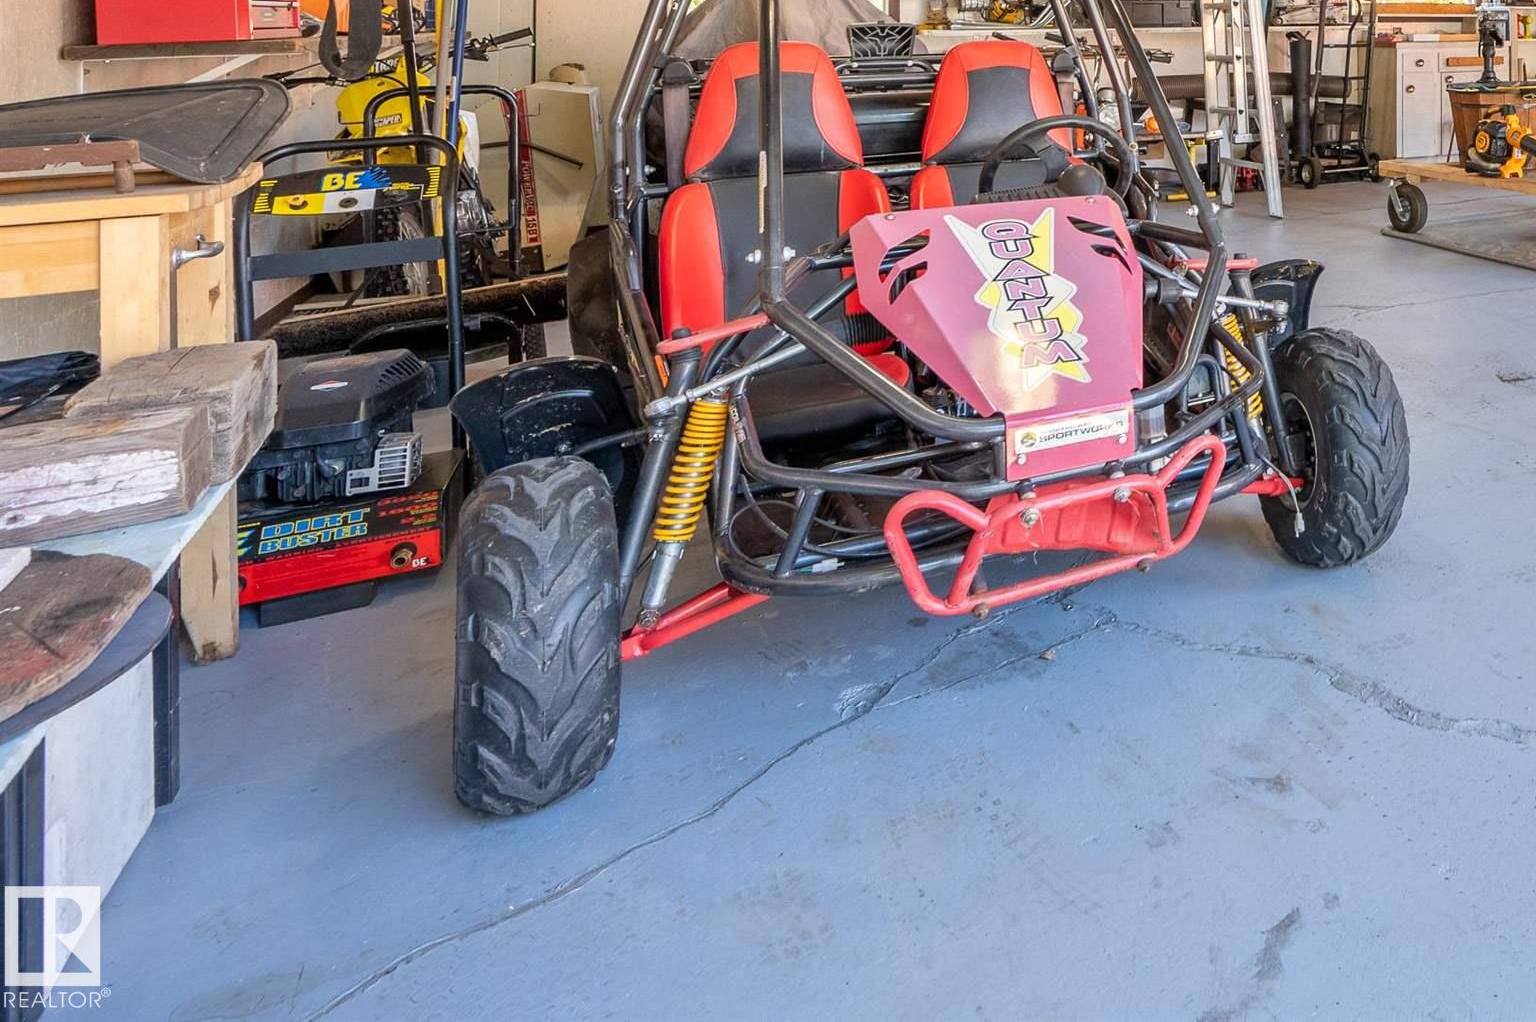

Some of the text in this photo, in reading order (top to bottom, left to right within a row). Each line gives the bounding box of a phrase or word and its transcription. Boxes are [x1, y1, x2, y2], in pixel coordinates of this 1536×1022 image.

[321, 171, 364, 192] BE
[982, 221, 1083, 369] QUANTUM
[258, 522, 369, 555] BUSTER
[261, 508, 370, 541] DIRT
